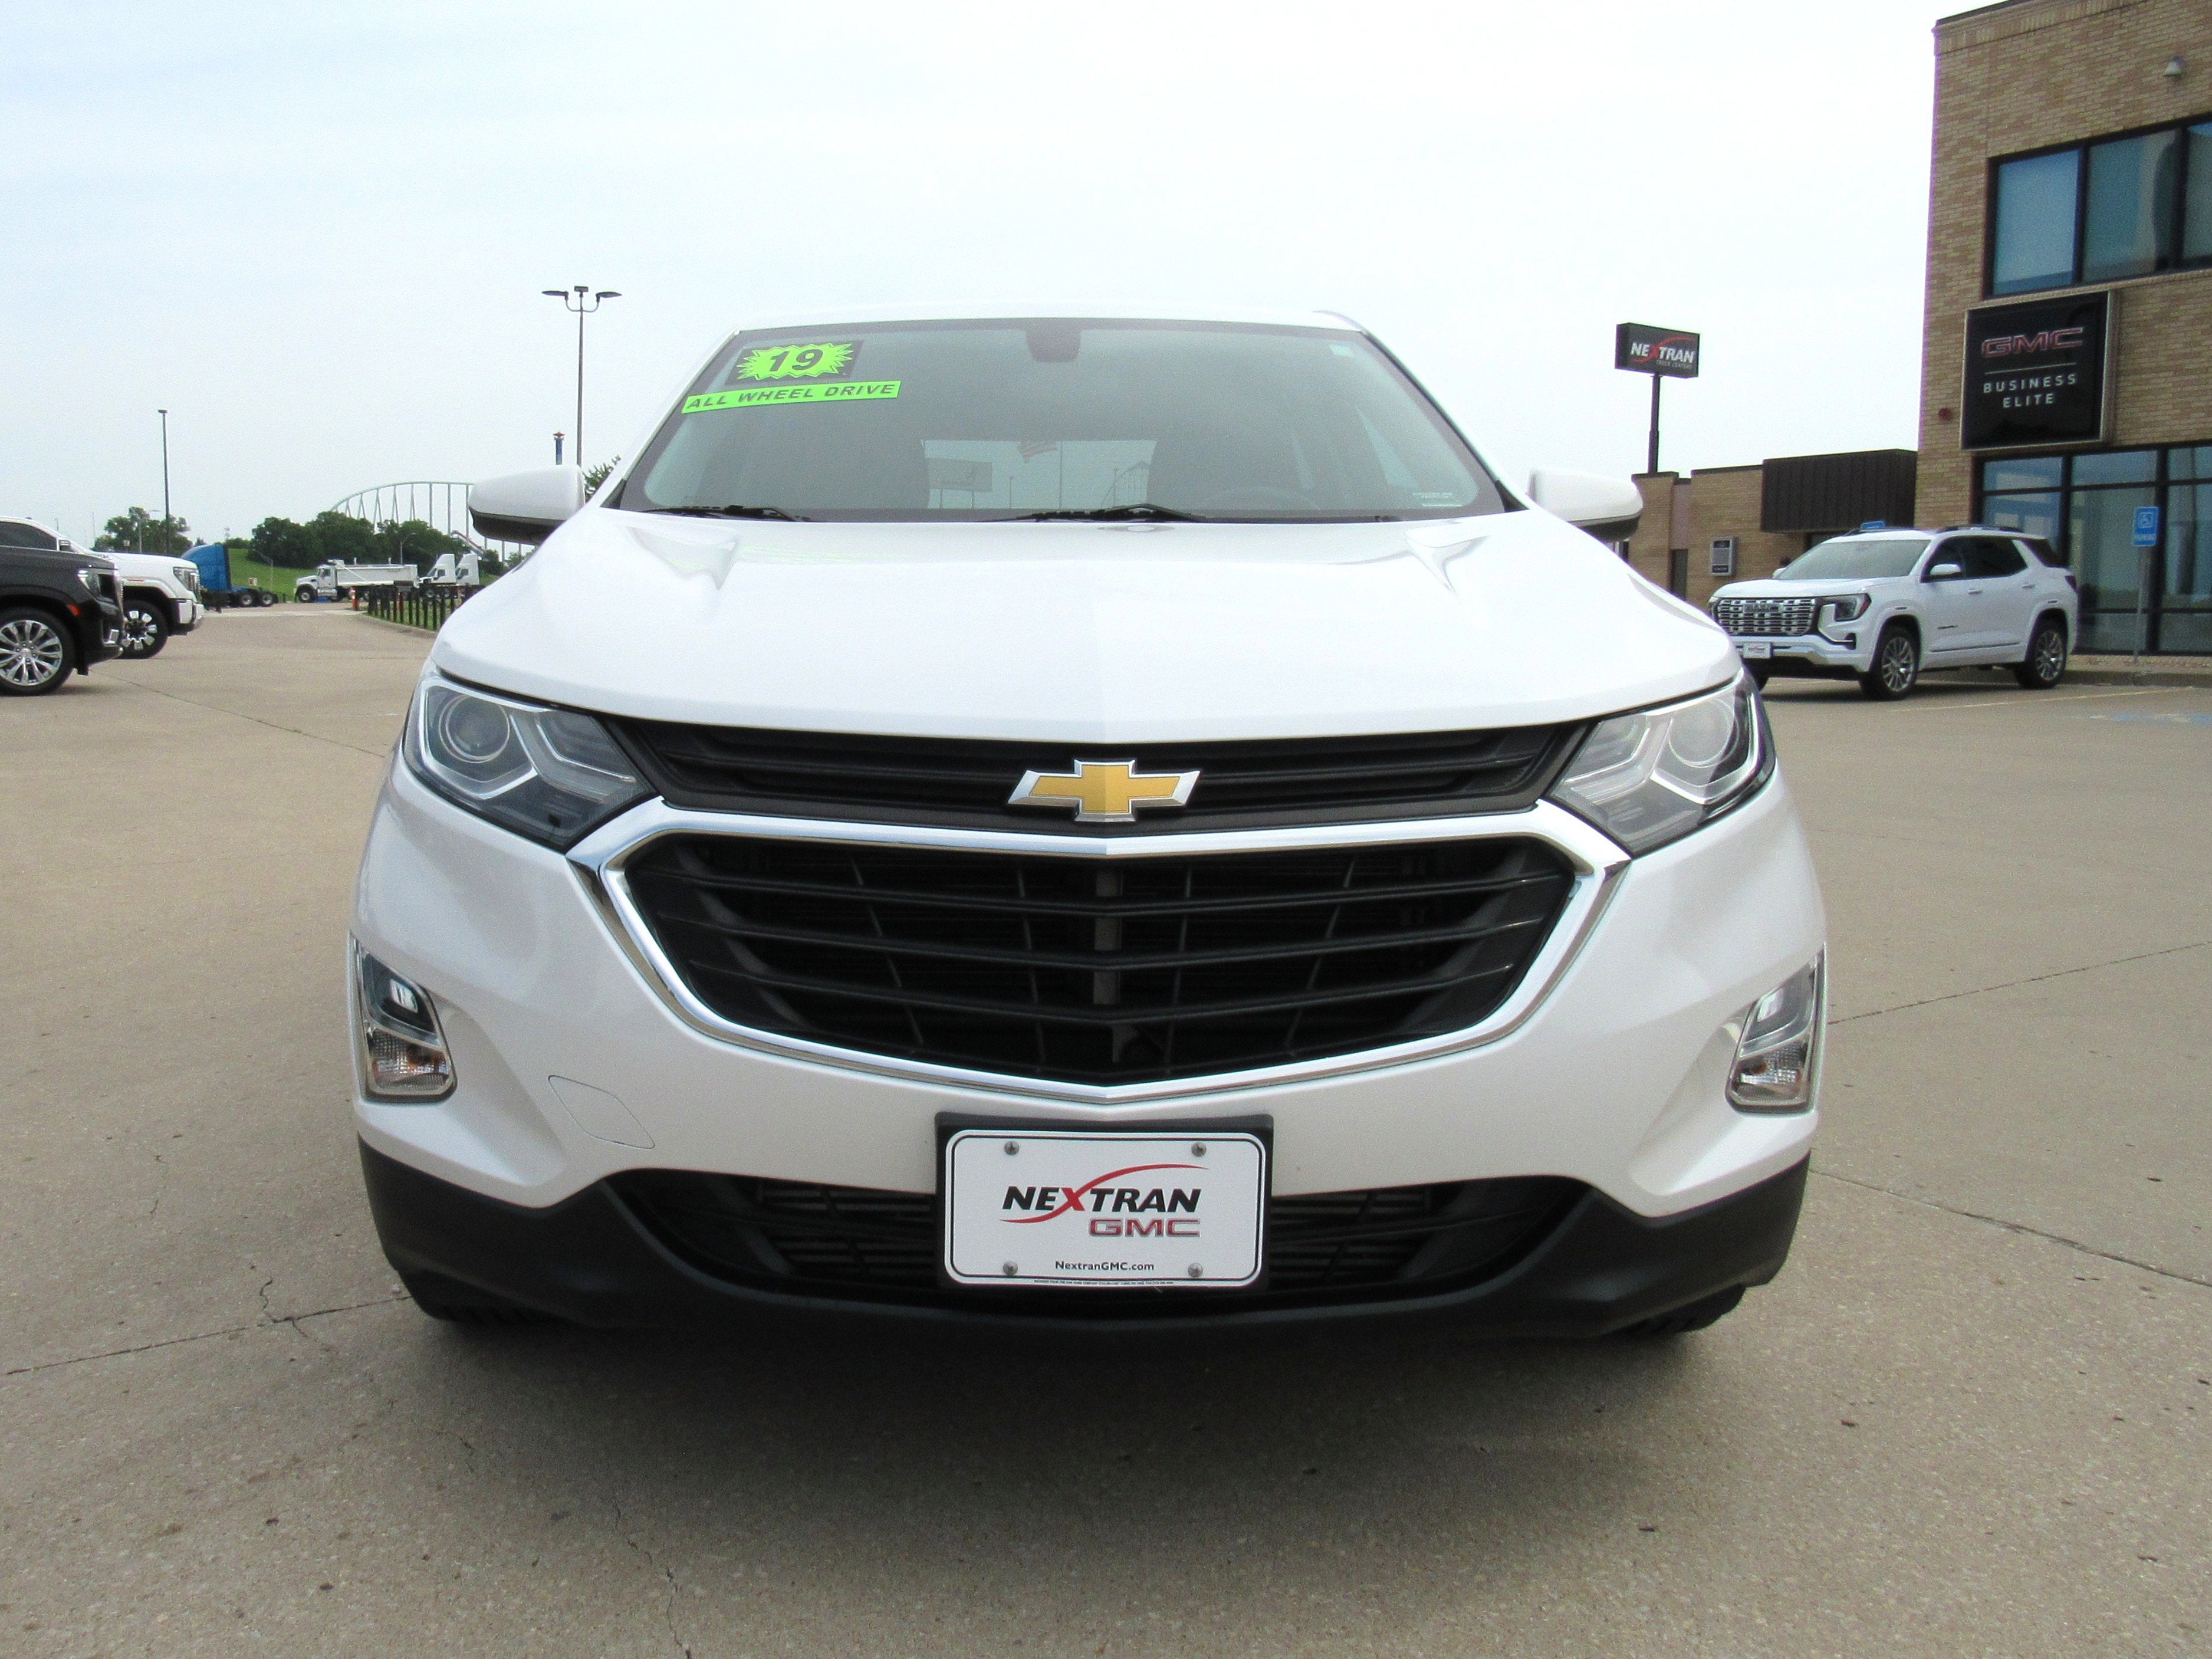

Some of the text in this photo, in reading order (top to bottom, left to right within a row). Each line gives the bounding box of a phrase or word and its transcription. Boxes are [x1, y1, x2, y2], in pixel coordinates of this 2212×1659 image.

[1631, 342, 1695, 363] NEXTRAN
[1981, 327, 2083, 357] GMC
[768, 349, 823, 372] 19
[1983, 373, 2077, 393] BUSINESS
[685, 383, 896, 409] ALL WHEEL DRIVE
[2003, 393, 2055, 409] ELITE
[1002, 1185, 1202, 1213] NEXTRAN
[1088, 1218, 1201, 1237] GMC
[1054, 1260, 1155, 1271] NextranGMC.com
